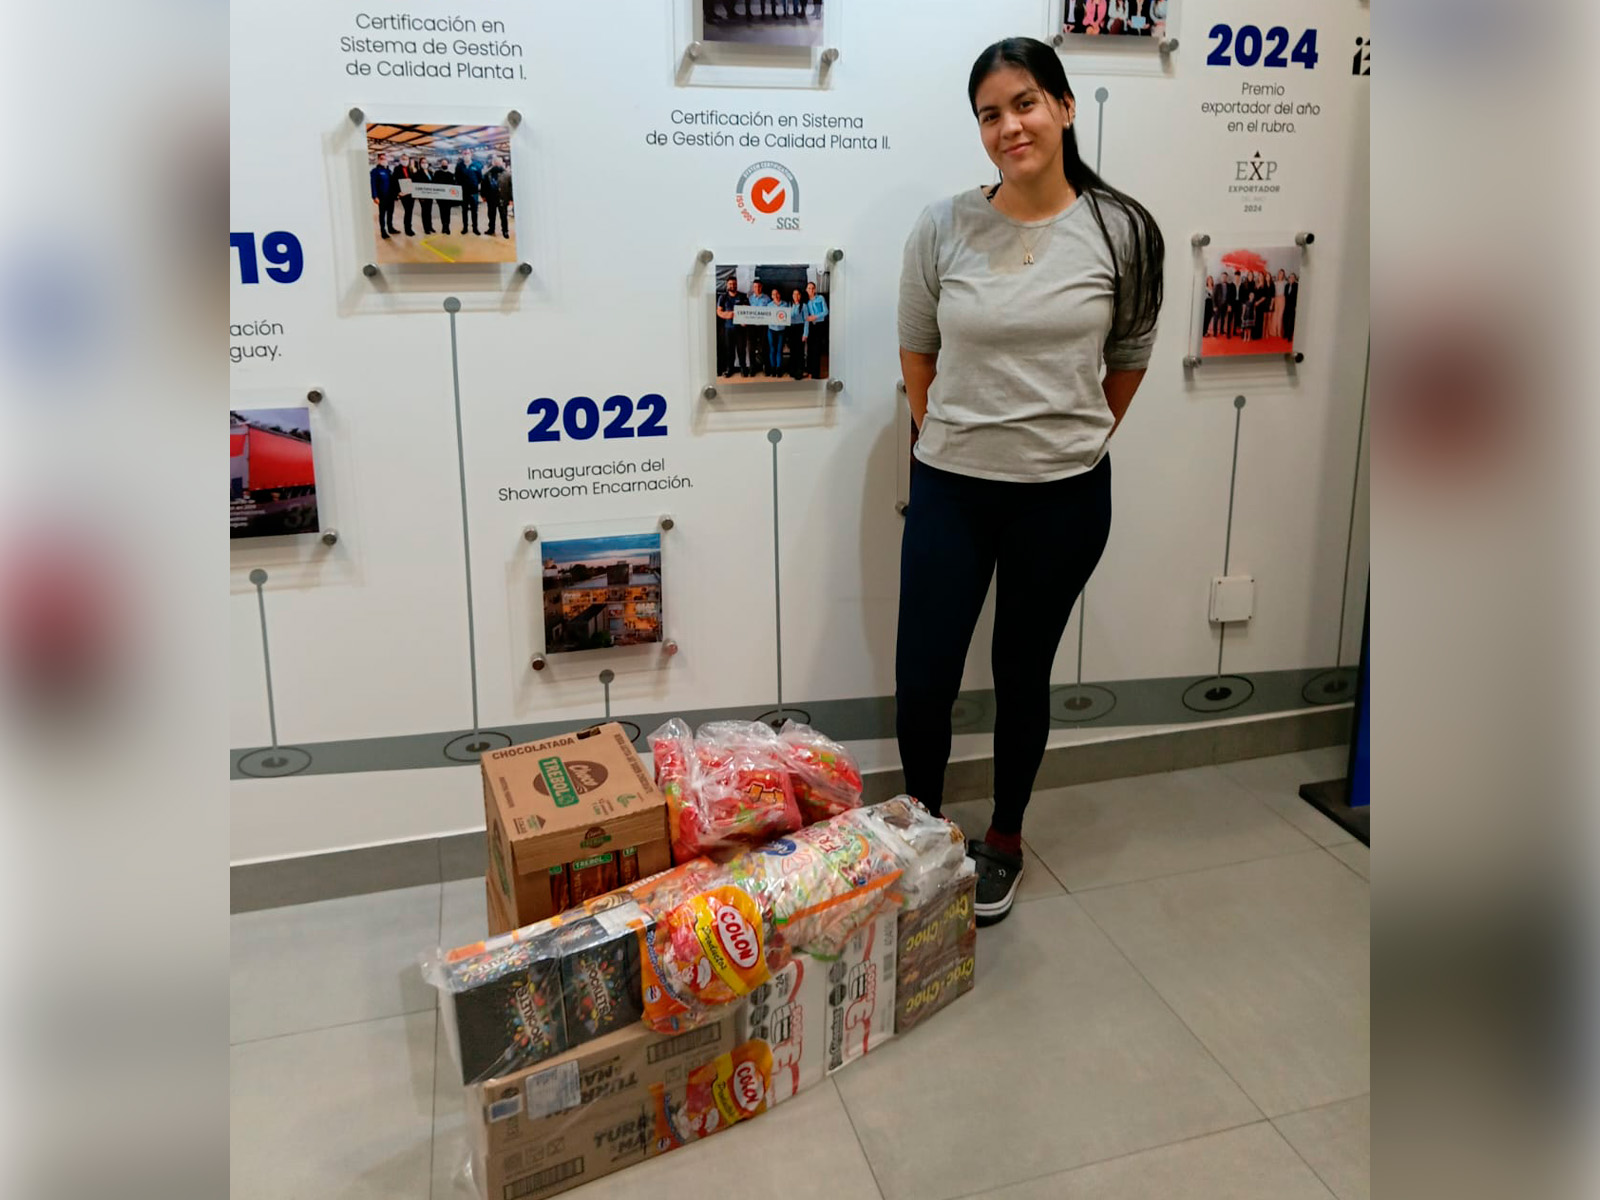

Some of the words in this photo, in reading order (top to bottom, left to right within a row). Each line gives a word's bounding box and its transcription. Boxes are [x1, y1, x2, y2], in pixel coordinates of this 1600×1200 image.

[356, 14, 476, 32] Certificación
[482, 21, 504, 33] en
[341, 36, 417, 53] Sistema
[423, 38, 447, 54] de
[453, 40, 522, 56] Gestión
[1207, 24, 1318, 69] 2024
[346, 60, 371, 75] de
[377, 61, 451, 77] Calidad
[457, 63, 513, 79] Planta
[1242, 82, 1285, 96] Premio
[671, 110, 773, 126] Certificación
[778, 116, 797, 127] en
[803, 113, 863, 128] Sistema
[1202, 101, 1271, 118] exportador
[1274, 102, 1293, 114] del
[1296, 103, 1320, 115] año
[1228, 122, 1243, 132] en
[1247, 120, 1258, 132] el
[1261, 120, 1295, 133] rubro.
[646, 131, 667, 145] de
[673, 131, 734, 146] Gestión
[739, 133, 760, 147] de
[765, 134, 825, 148] Calidad
[831, 135, 877, 149] Planta
[1237, 162, 1277, 180] EXP
[777, 217, 799, 230] SGS
[230, 231, 303, 284] 19
[230, 320, 283, 336] ación
[230, 346, 281, 363] guay.
[527, 394, 667, 442] 2022
[528, 460, 636, 481] Inauguración
[641, 458, 664, 472] del
[498, 483, 588, 501] Showroom
[592, 474, 693, 495] Encarnación.
[492, 737, 575, 760] CHOCOLATADA
[543, 758, 567, 802] TREBOL
[720, 912, 755, 960] COLON
[906, 919, 939, 951] Choc
[701, 926, 727, 970] Productos
[586, 961, 612, 1014] ROCKLETS
[775, 973, 785, 989] 24
[906, 980, 939, 1012] Choc
[516, 984, 545, 1045] ROCKLETS
